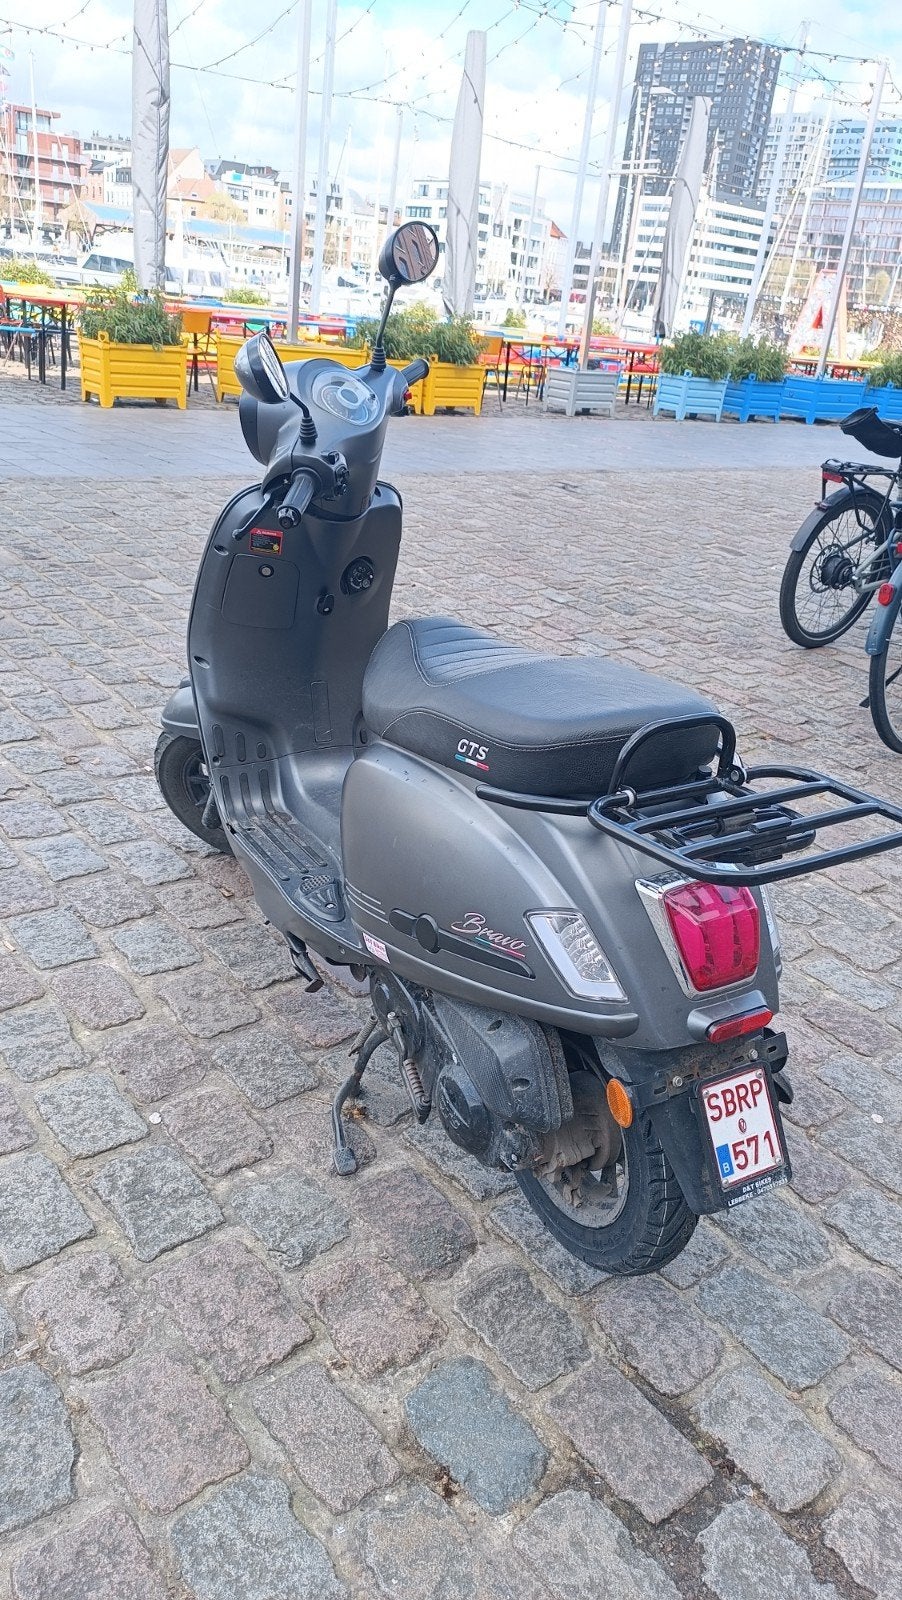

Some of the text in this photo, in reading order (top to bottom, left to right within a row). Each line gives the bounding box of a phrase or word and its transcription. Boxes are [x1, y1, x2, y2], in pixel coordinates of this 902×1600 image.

[457, 738, 489, 760] GTS
[451, 911, 528, 950] Bravo
[707, 1079, 763, 1122] SBRP
[732, 1130, 775, 1170] 571
[722, 1162, 731, 1173] B
[742, 1176, 772, 1193] D&T BIKES
